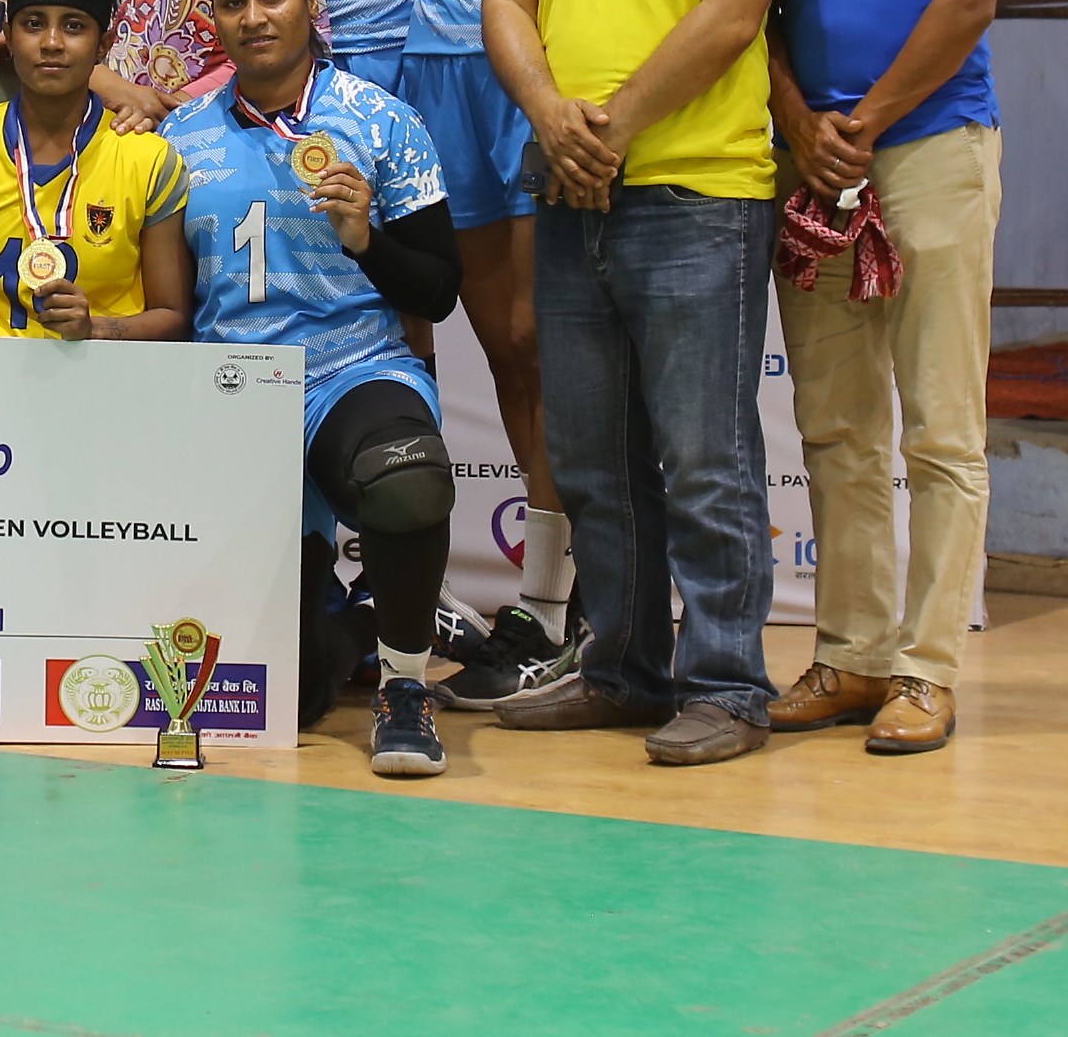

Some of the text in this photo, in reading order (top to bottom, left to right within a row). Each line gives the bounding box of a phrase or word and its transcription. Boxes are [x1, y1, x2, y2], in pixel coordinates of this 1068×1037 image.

[306, 153, 325, 164] FIRST
[233, 200, 267, 304] 1
[33, 520, 198, 542] VOLLEYBALL
[219, 700, 259, 713] BANK LTD.
